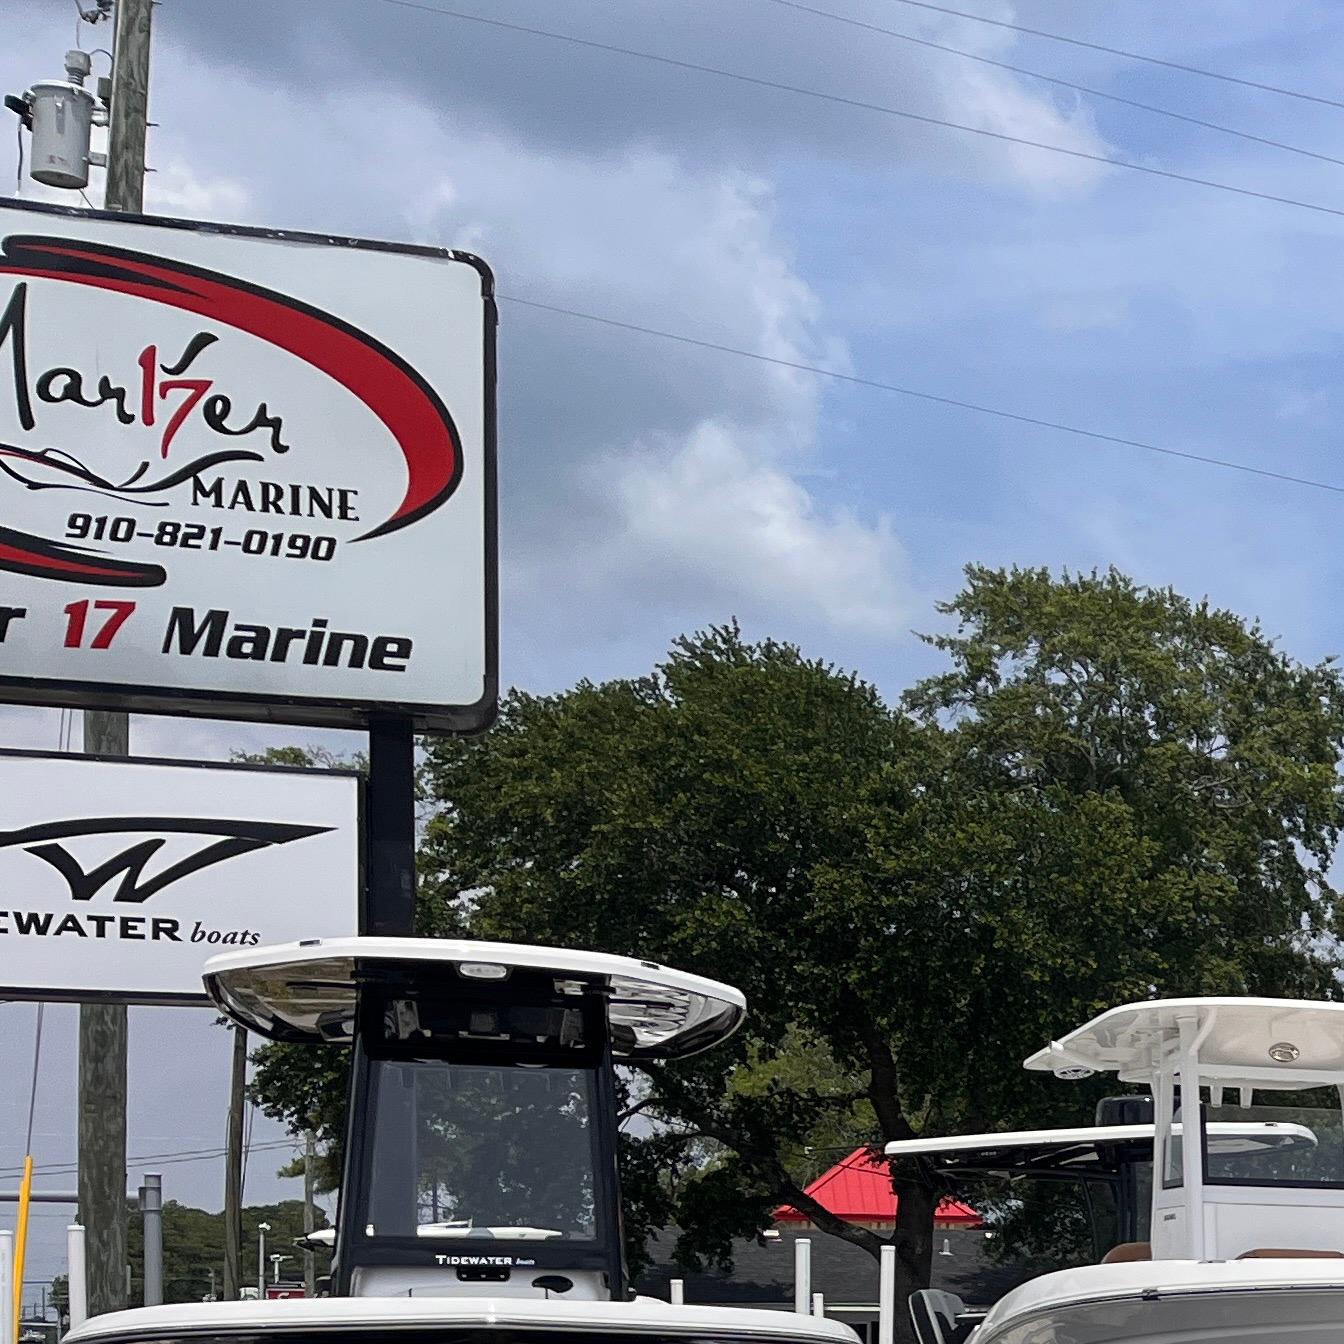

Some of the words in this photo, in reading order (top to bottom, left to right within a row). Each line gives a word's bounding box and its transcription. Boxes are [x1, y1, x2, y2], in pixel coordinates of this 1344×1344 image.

[191, 475, 360, 522] MARINE
[65, 513, 338, 562] 910-821-0190
[63, 600, 136, 650] 17
[162, 606, 413, 672] Marine
[190, 920, 260, 946] boats
[435, 1254, 512, 1265] TIDEWATER
